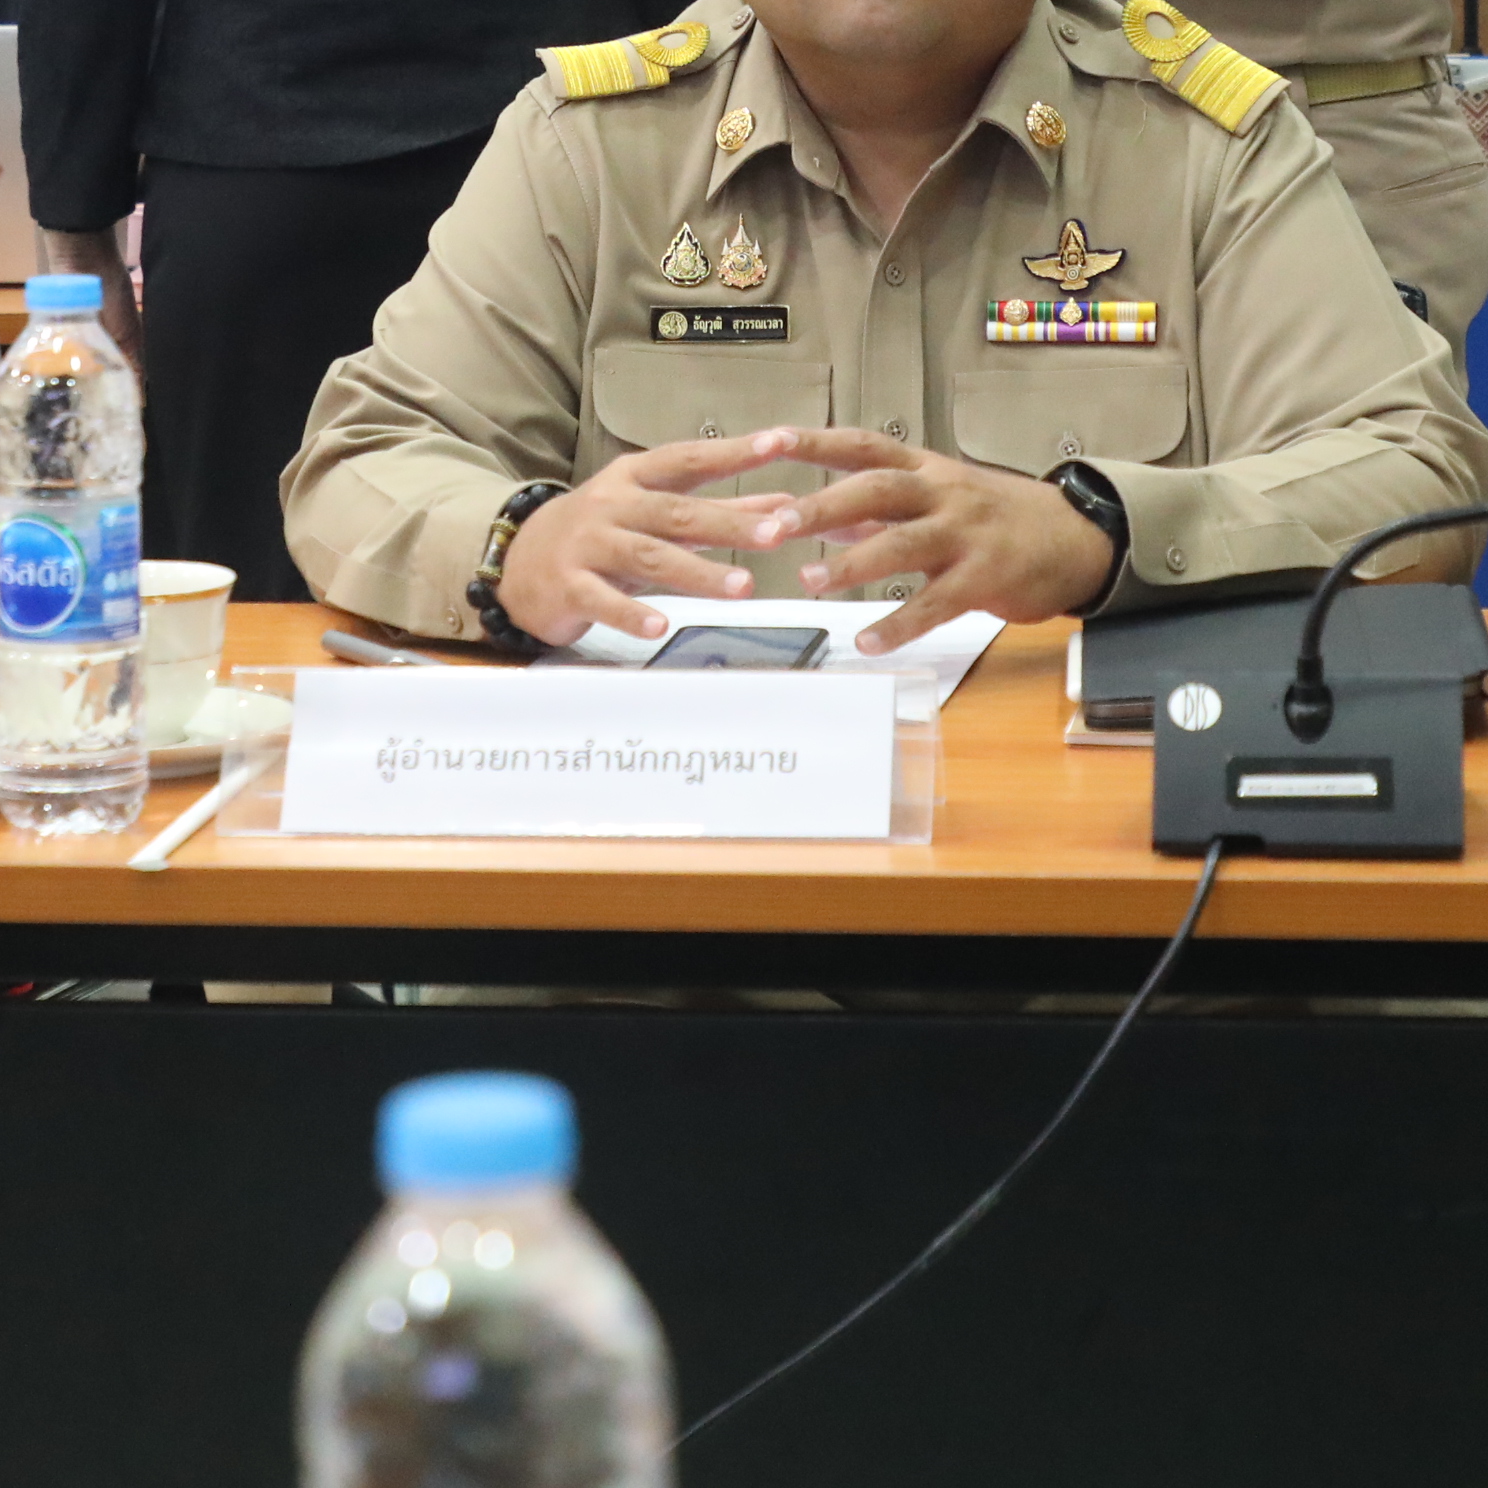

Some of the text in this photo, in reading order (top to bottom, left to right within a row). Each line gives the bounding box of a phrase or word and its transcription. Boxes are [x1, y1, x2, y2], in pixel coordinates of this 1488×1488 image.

[376, 737, 798, 786] ผู้อำนวยการสำนักกฎหมาย
